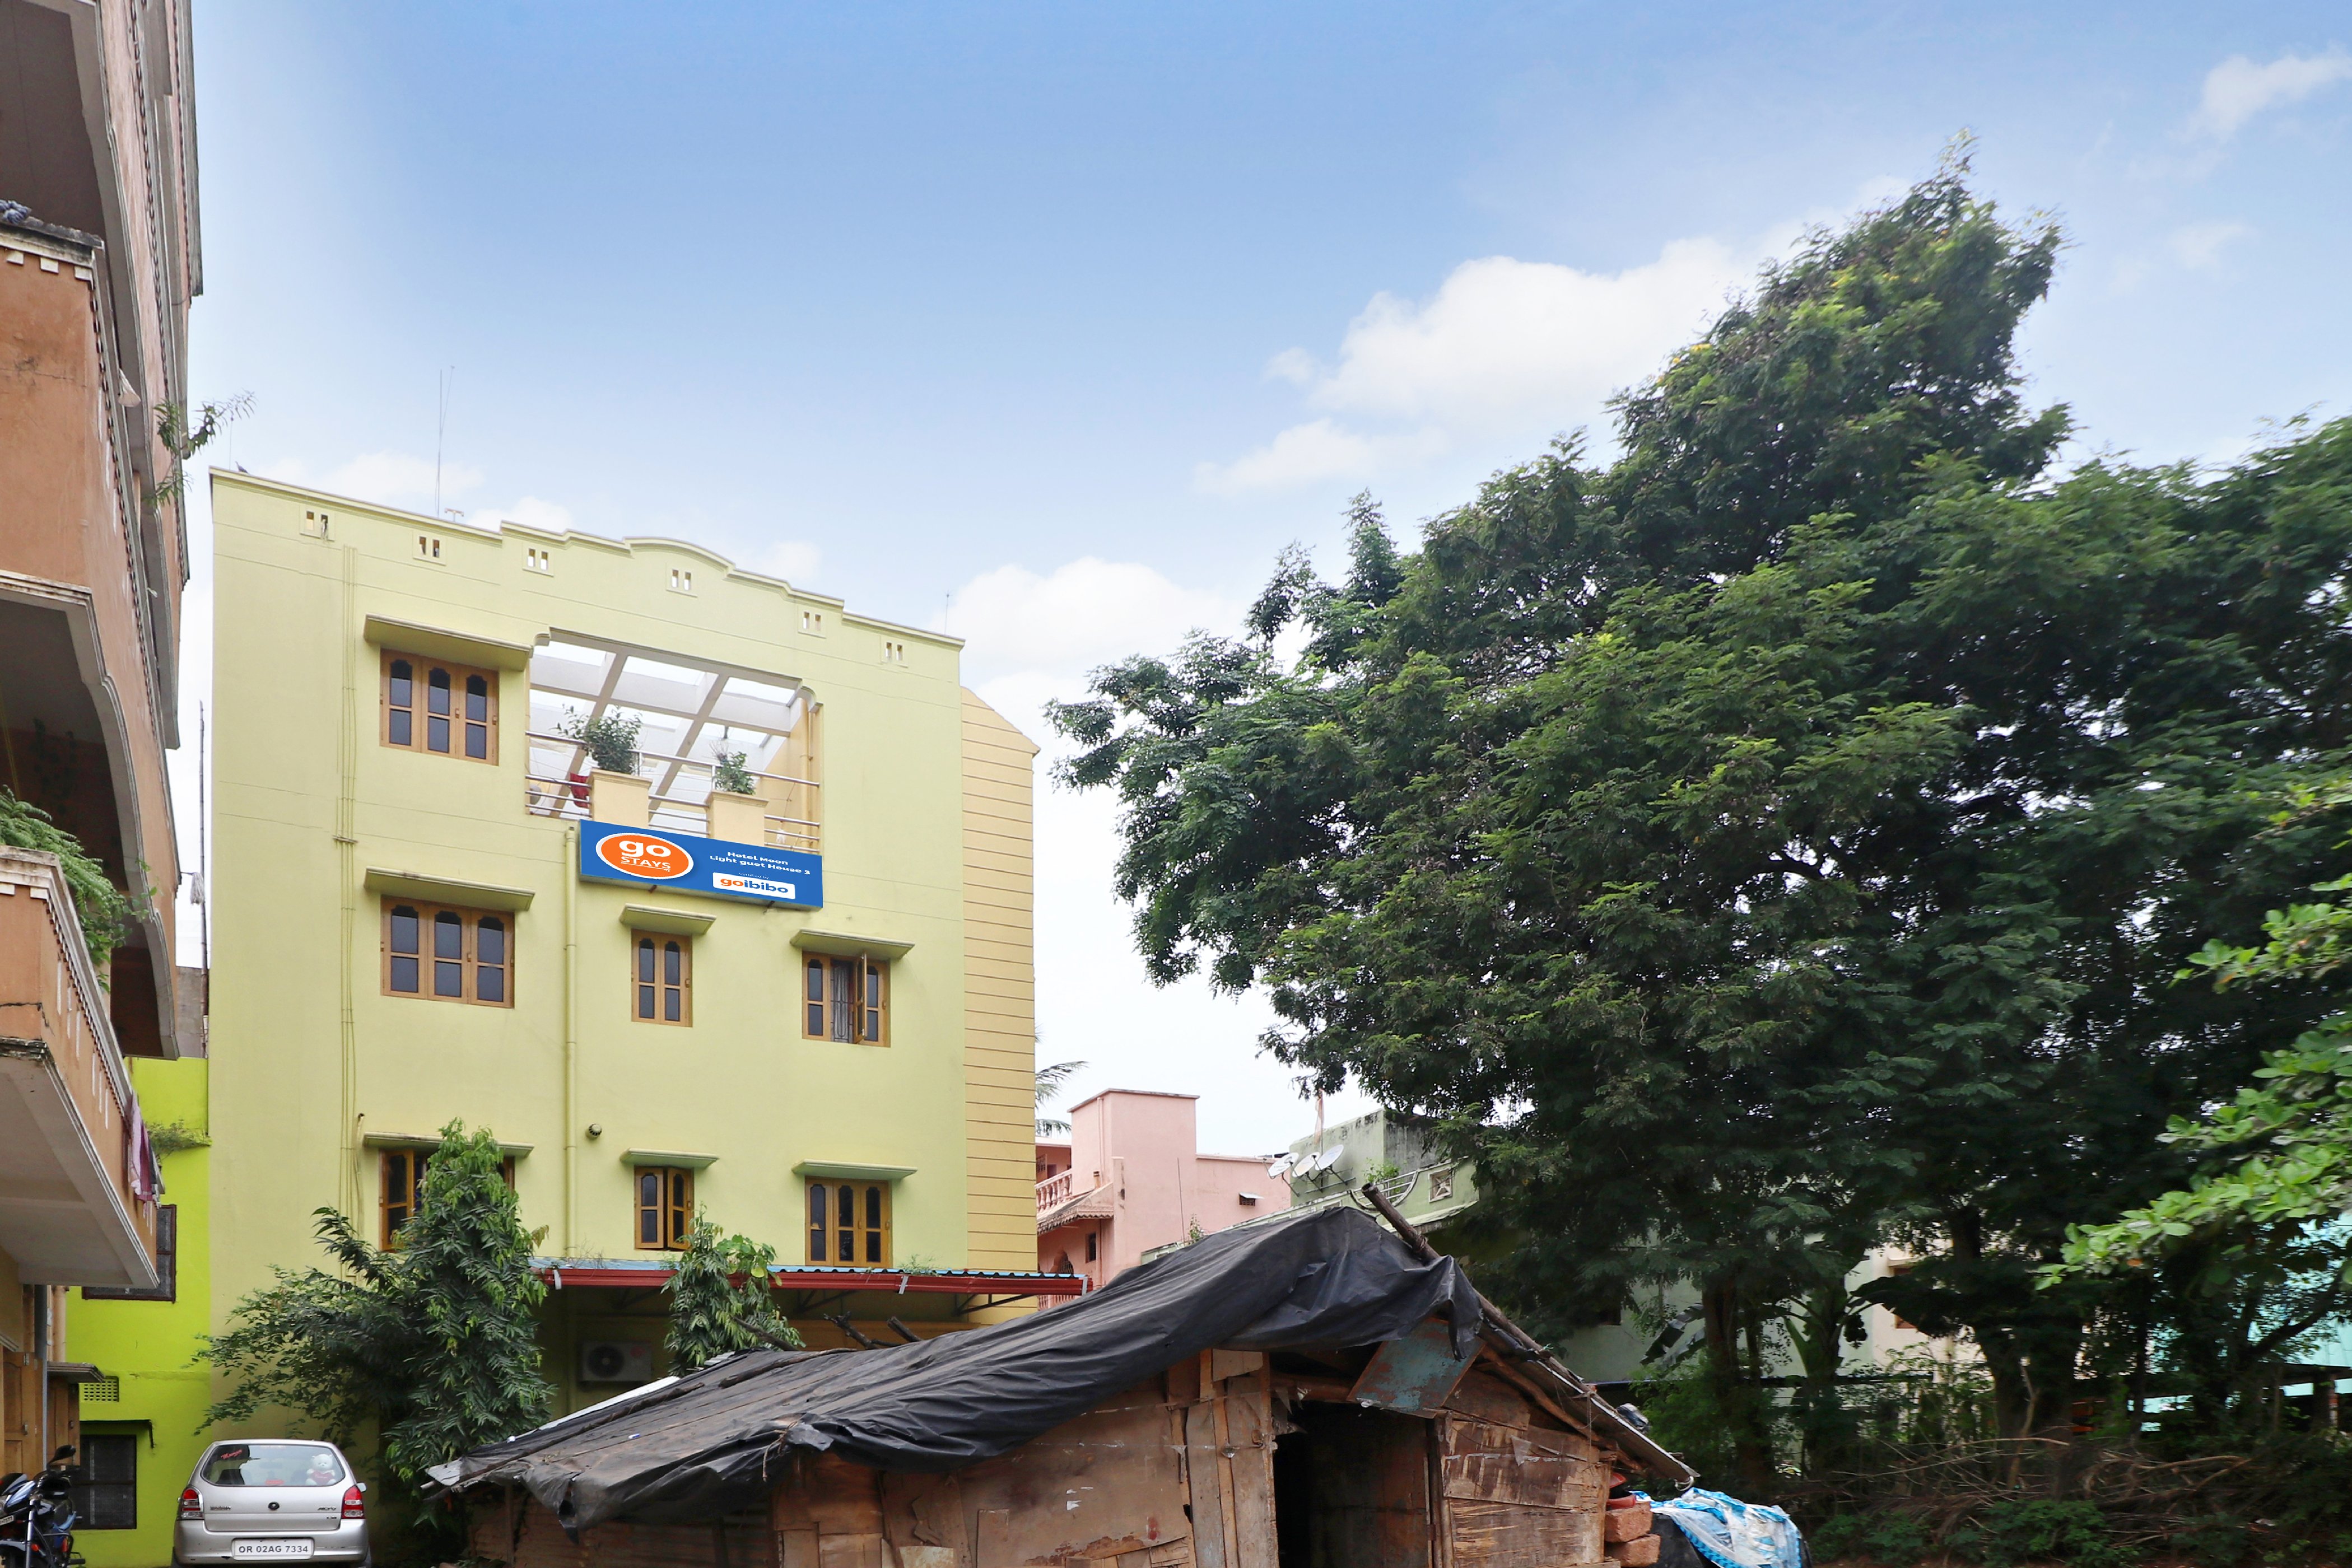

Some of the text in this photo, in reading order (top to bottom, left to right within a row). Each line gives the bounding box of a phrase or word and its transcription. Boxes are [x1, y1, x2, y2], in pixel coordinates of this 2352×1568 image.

[619, 841, 671, 857] go
[621, 856, 671, 869] STAYS
[727, 852, 788, 865] Hotel Moon
[767, 864, 802, 873] House
[720, 879, 788, 893] goibibo
